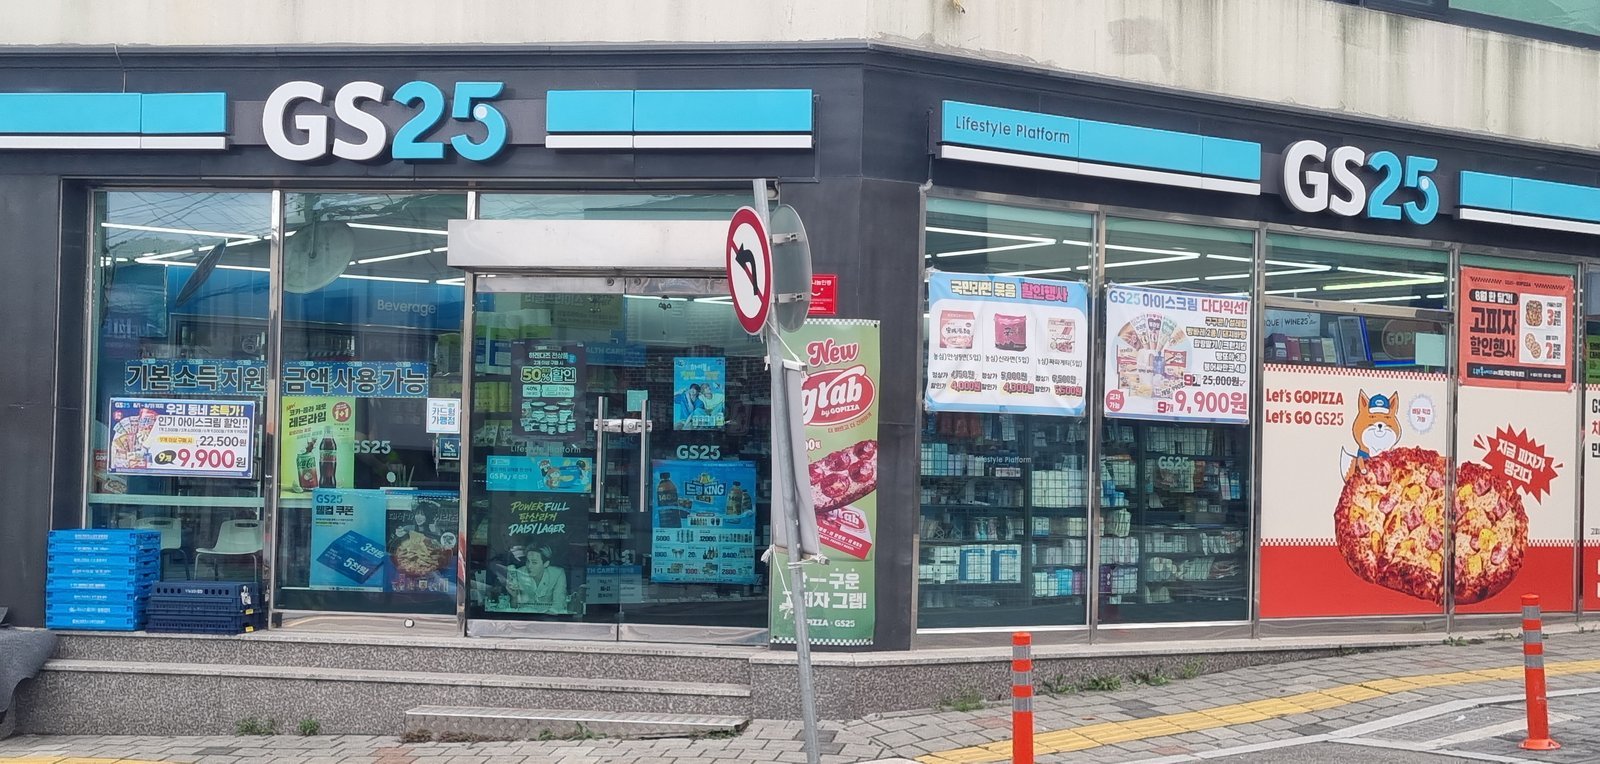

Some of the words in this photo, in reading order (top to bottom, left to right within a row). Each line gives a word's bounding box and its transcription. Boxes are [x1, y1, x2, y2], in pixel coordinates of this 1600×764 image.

[262, 80, 508, 162] GS25
[954, 115, 1012, 137] Lifestyle
[1015, 122, 1071, 144] Platform
[1282, 138, 1440, 225] GS25
[951, 280, 993, 297] 국민라면
[994, 281, 1017, 298] 묶음
[1021, 281, 1069, 303] 할인행사
[378, 298, 436, 314] Beverage
[1109, 290, 1141, 305] GS25
[1142, 293, 1198, 312] 아이스크림
[1201, 299, 1248, 315] 다다익선!
[1285, 317, 1308, 327] WINE25
[1469, 307, 1518, 336] 고피자
[1547, 308, 1554, 326] 3
[807, 339, 859, 366] New
[1469, 336, 1517, 359] 할인행사
[1545, 342, 1553, 360] 2
[126, 364, 171, 391] 기본
[174, 364, 218, 392] 소득
[221, 366, 267, 392] 지원
[285, 367, 330, 393] 금액
[333, 368, 377, 393] 사용
[381, 369, 426, 394] 가능
[552, 368, 576, 383] 할인
[1175, 390, 1248, 415] 9,900원
[1266, 388, 1292, 403] Let's
[1294, 389, 1344, 406] GOPIZZA
[166, 404, 186, 416] 우리
[188, 405, 208, 416] 동네
[209, 405, 245, 417] 초특가!
[830, 404, 860, 414] GOPIZZA
[1265, 409, 1292, 424] Let's
[1294, 410, 1312, 425] GO
[1314, 411, 1344, 426] GS25
[158, 417, 176, 428] 인기
[178, 417, 222, 429] 아이스크림
[288, 410, 327, 429] 레몬라임
[177, 448, 247, 469] 9,900원
[677, 445, 721, 460] GS25
[1005, 455, 1032, 465] Platform
[1496, 438, 1517, 460] 지금
[1517, 447, 1546, 473] 피자가
[1158, 455, 1190, 470] GS25
[1504, 459, 1533, 485] 땡긴다
[316, 494, 343, 504] GS25
[508, 524, 538, 537] DAISY
[536, 523, 566, 535] LAGER
[828, 570, 860, 590] 구운
[832, 592, 867, 610] 그랩!
[834, 619, 856, 628] GS25
